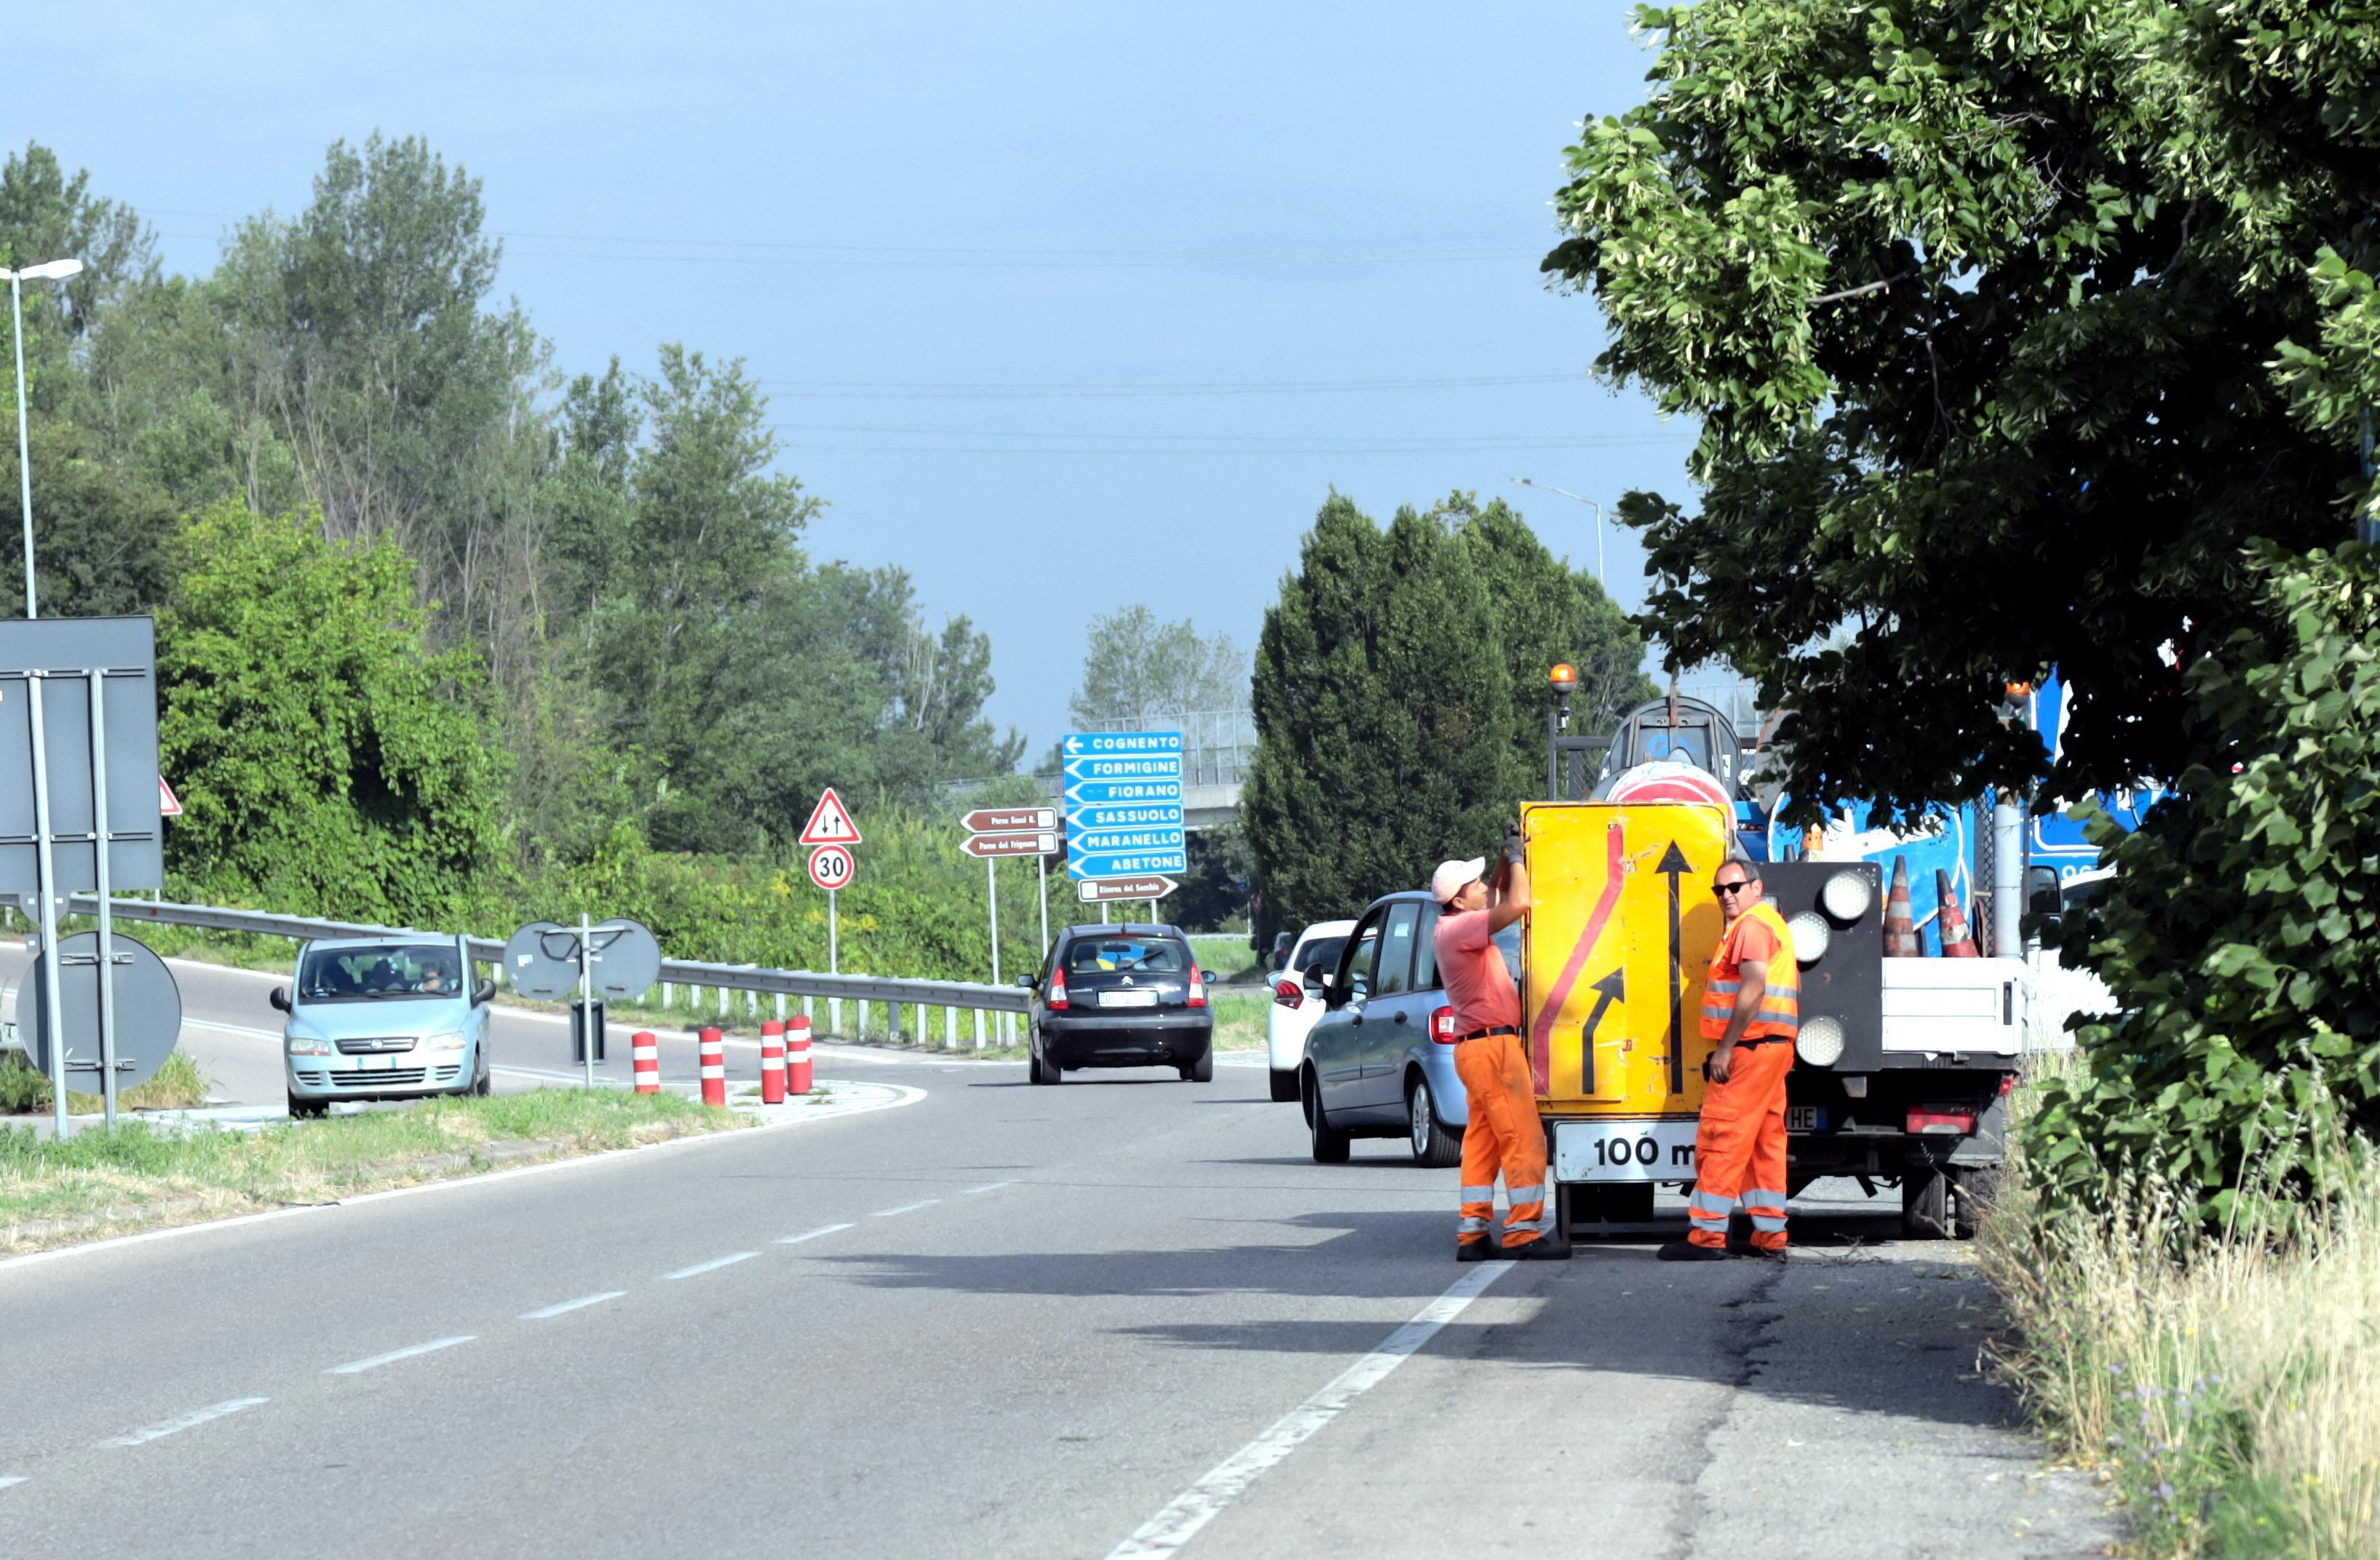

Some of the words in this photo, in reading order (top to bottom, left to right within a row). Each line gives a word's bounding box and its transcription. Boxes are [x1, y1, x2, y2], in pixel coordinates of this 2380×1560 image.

[1092, 736, 1179, 749] COGNENTO
[1093, 761, 1178, 775] FORMIGINE
[1108, 785, 1178, 798] FIORANO
[1095, 808, 1179, 823] SASSUOLO
[1087, 831, 1181, 847] MARANELLO
[820, 857, 844, 877] 30
[1111, 855, 1183, 870] ABETONE
[1594, 1137, 1659, 1165] 100
[1671, 1144, 1697, 1165] m
